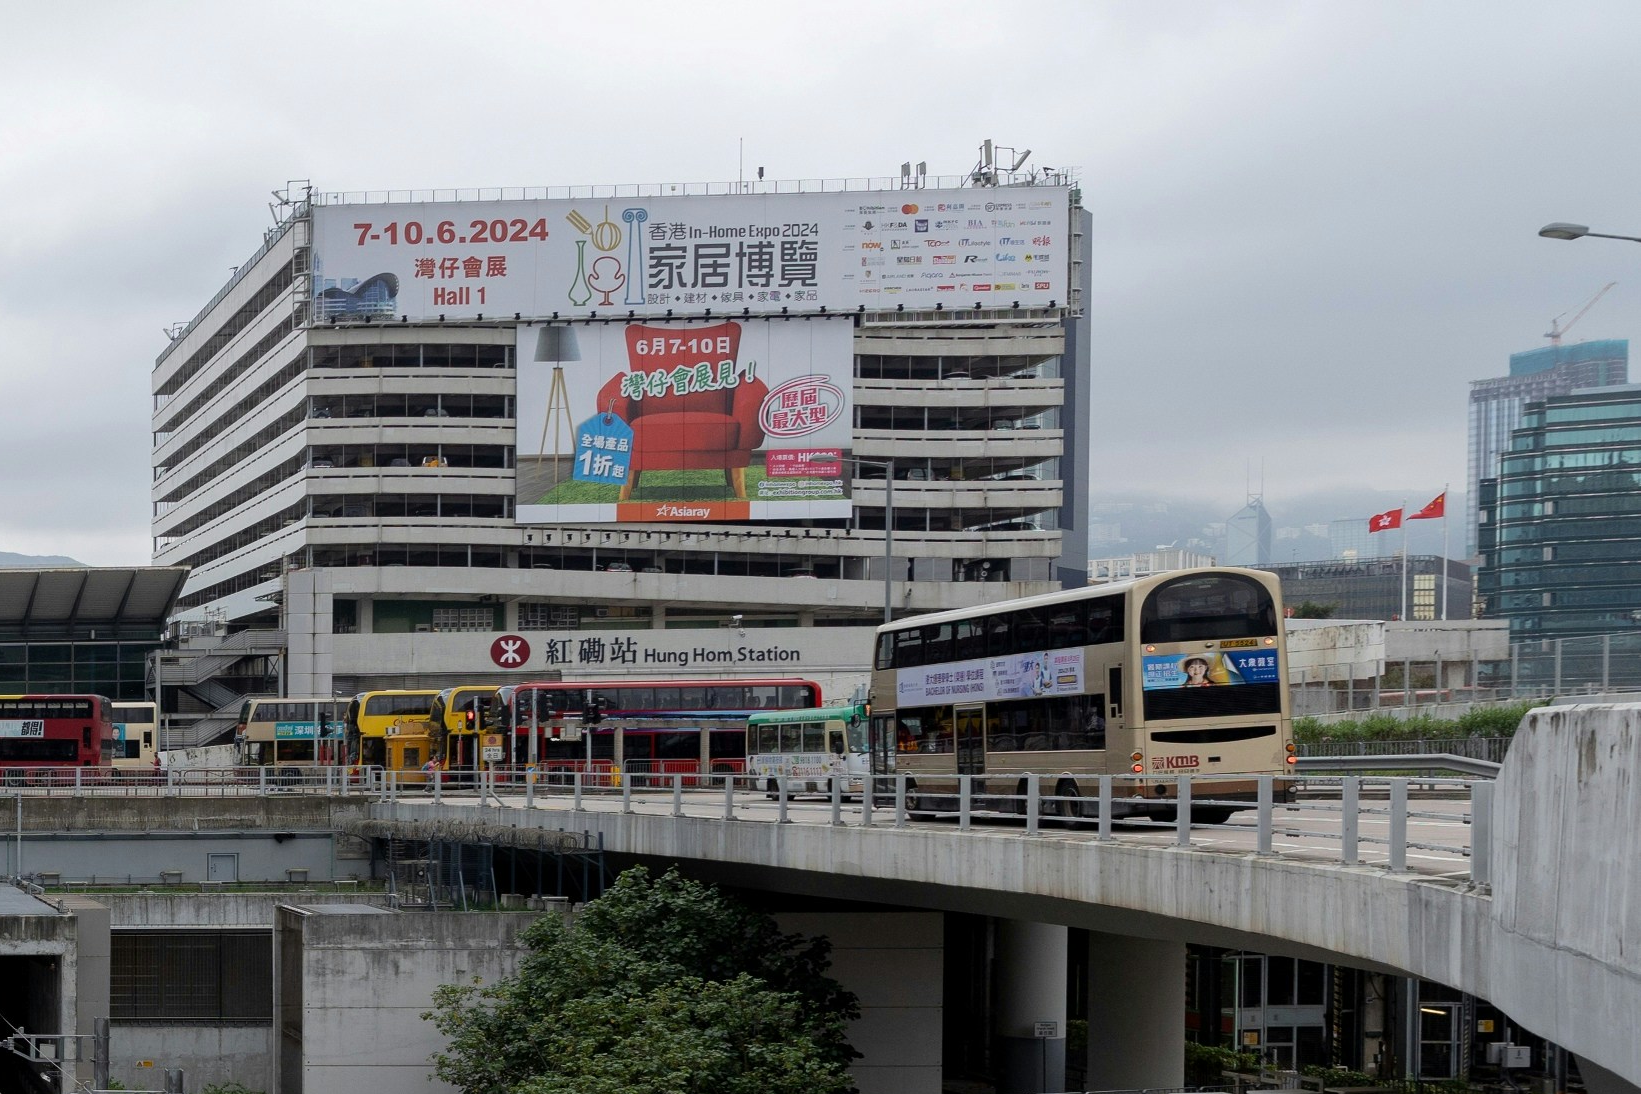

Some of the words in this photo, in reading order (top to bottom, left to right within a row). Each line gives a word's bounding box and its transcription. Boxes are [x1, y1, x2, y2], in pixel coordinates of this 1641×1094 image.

[353, 218, 549, 246] 7-10.6.2024
[648, 222, 686, 240] 香港
[689, 224, 746, 239] In-Home
[748, 224, 780, 239] Expo
[782, 222, 819, 237] 2024
[414, 256, 508, 279] 灣仔會展
[648, 240, 818, 290] 家居博覽
[433, 286, 470, 306] Hall
[478, 286, 486, 304] 1
[648, 293, 670, 304] 設計
[684, 292, 707, 304] 建材
[720, 291, 744, 303] 傢具
[758, 290, 781, 302] 家電
[794, 290, 818, 302] 家品
[636, 336, 731, 356] 6月7-10日
[772, 406, 826, 430] 最大型
[581, 433, 629, 452] 全場產品
[578, 451, 625, 478] 1折起
[670, 506, 710, 518] Asiaray
[545, 636, 638, 665] 紅磡站
[644, 648, 689, 666] Hung
[693, 648, 732, 662] Hom
[736, 646, 801, 662] Station
[1166, 755, 1200, 768] KMB
